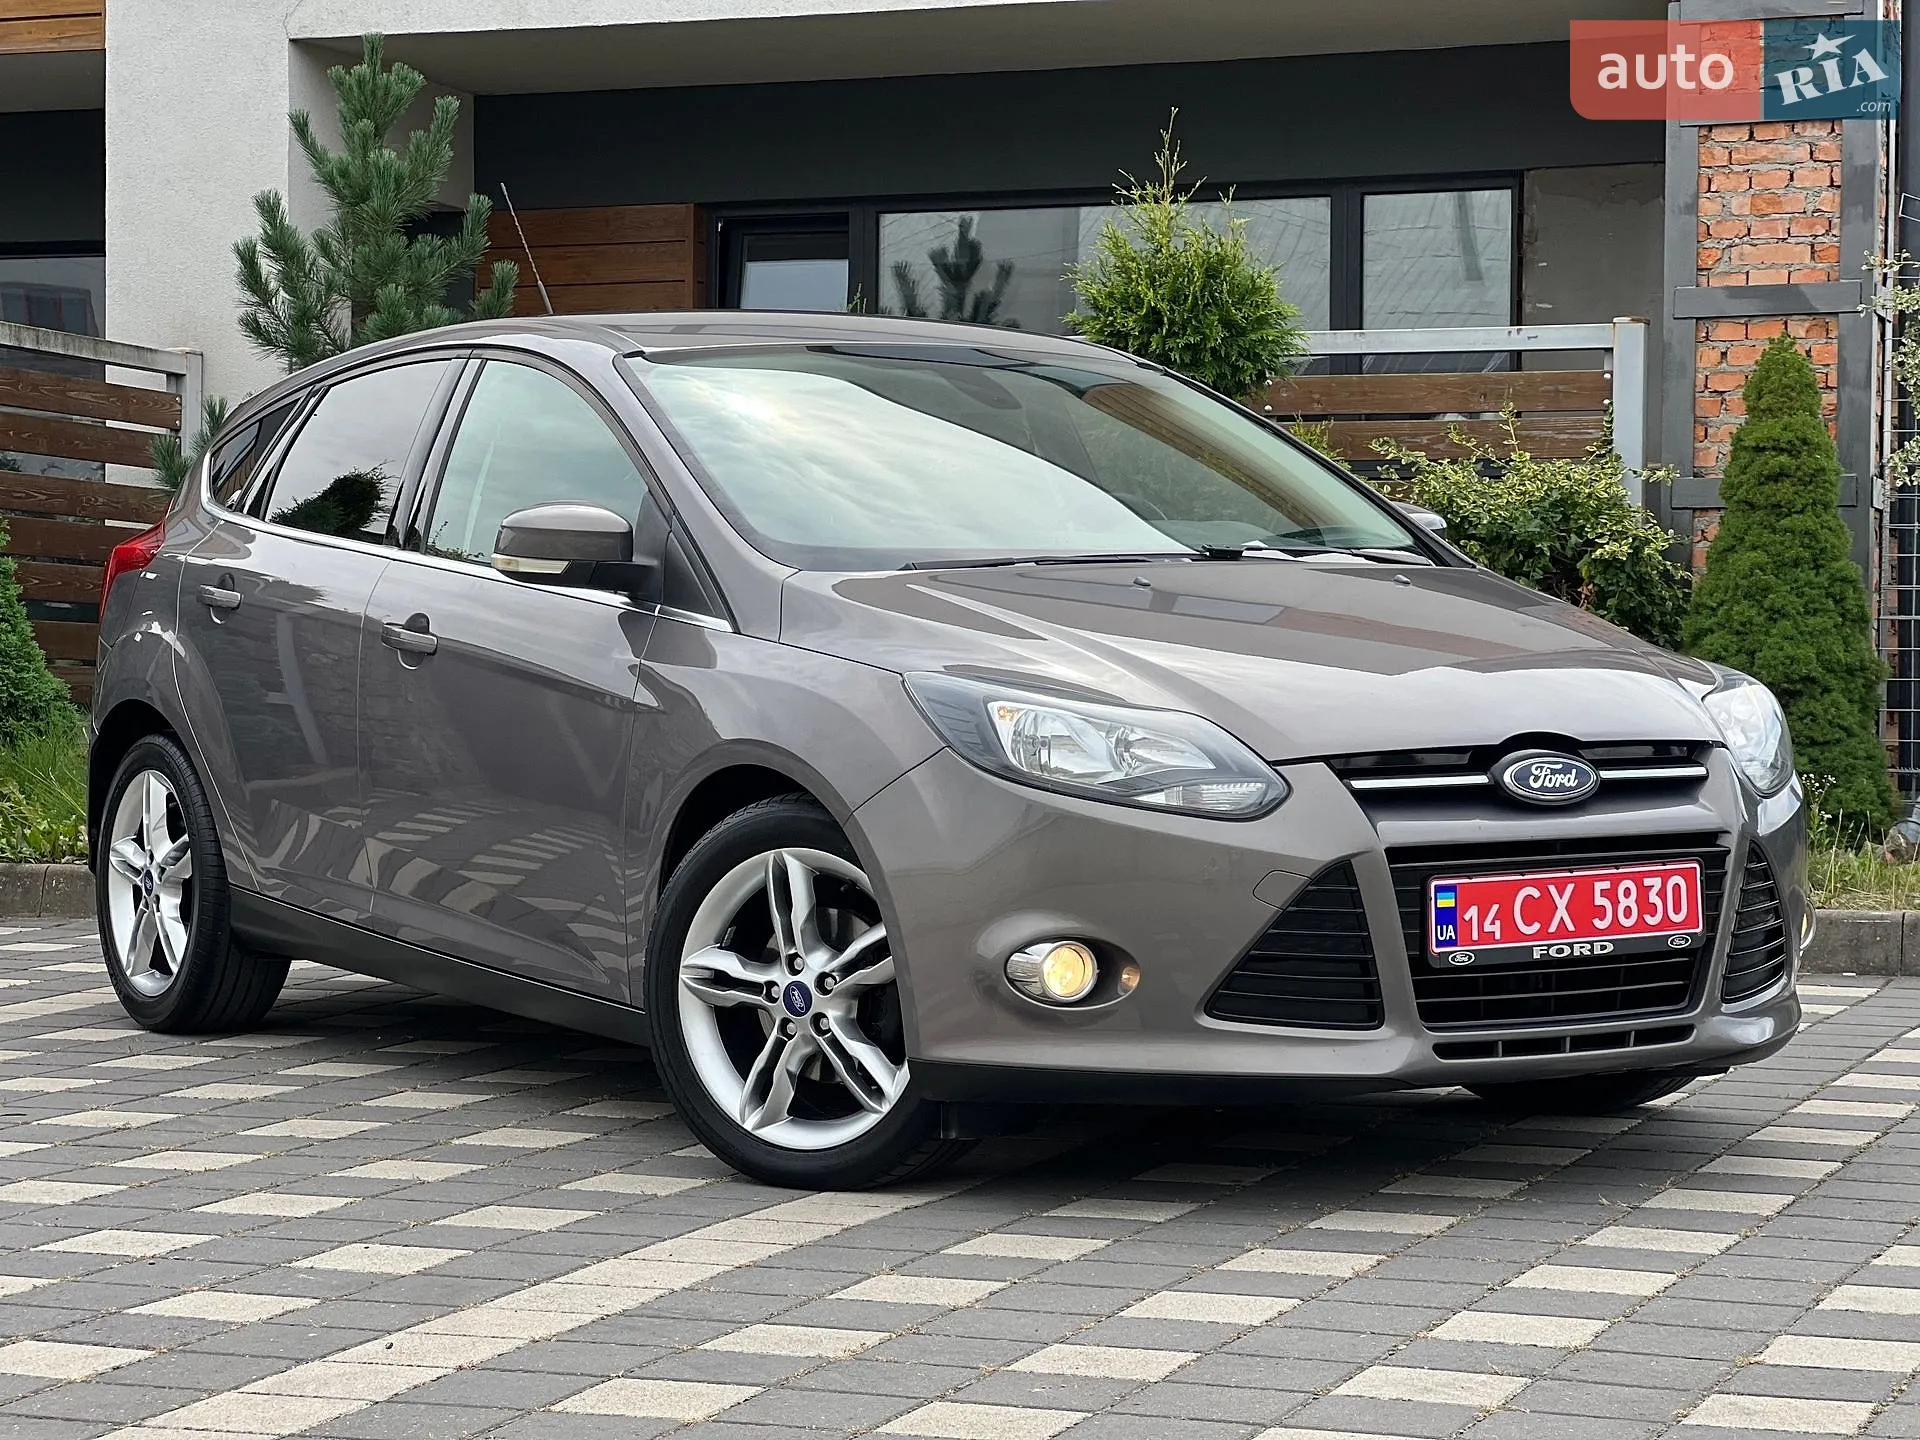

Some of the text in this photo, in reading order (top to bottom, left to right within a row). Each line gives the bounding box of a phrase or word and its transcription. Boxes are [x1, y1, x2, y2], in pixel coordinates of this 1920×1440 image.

[1529, 763, 1579, 788] Ford
[1462, 875, 1689, 941] 14 CX 5830
[1436, 925, 1456, 941] UA
[1532, 941, 1615, 959] FORD
